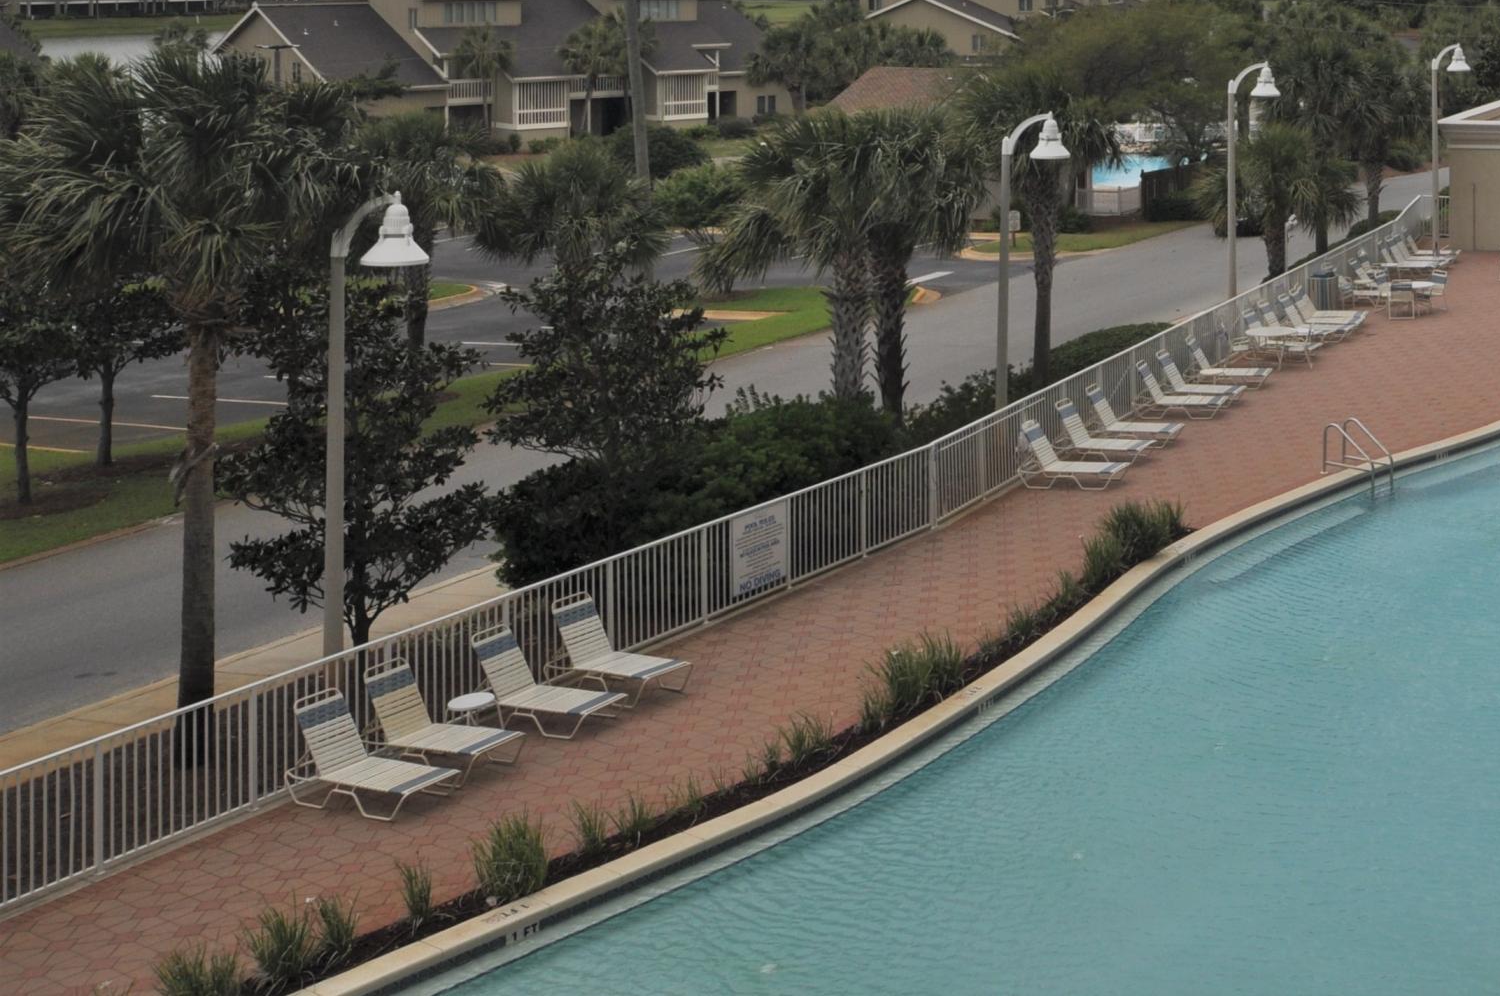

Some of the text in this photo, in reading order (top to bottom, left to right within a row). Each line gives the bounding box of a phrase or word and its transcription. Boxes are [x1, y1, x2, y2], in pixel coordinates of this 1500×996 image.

[740, 580, 752, 591] NO
[754, 569, 781, 586] DIVING
[524, 923, 537, 936] FT
